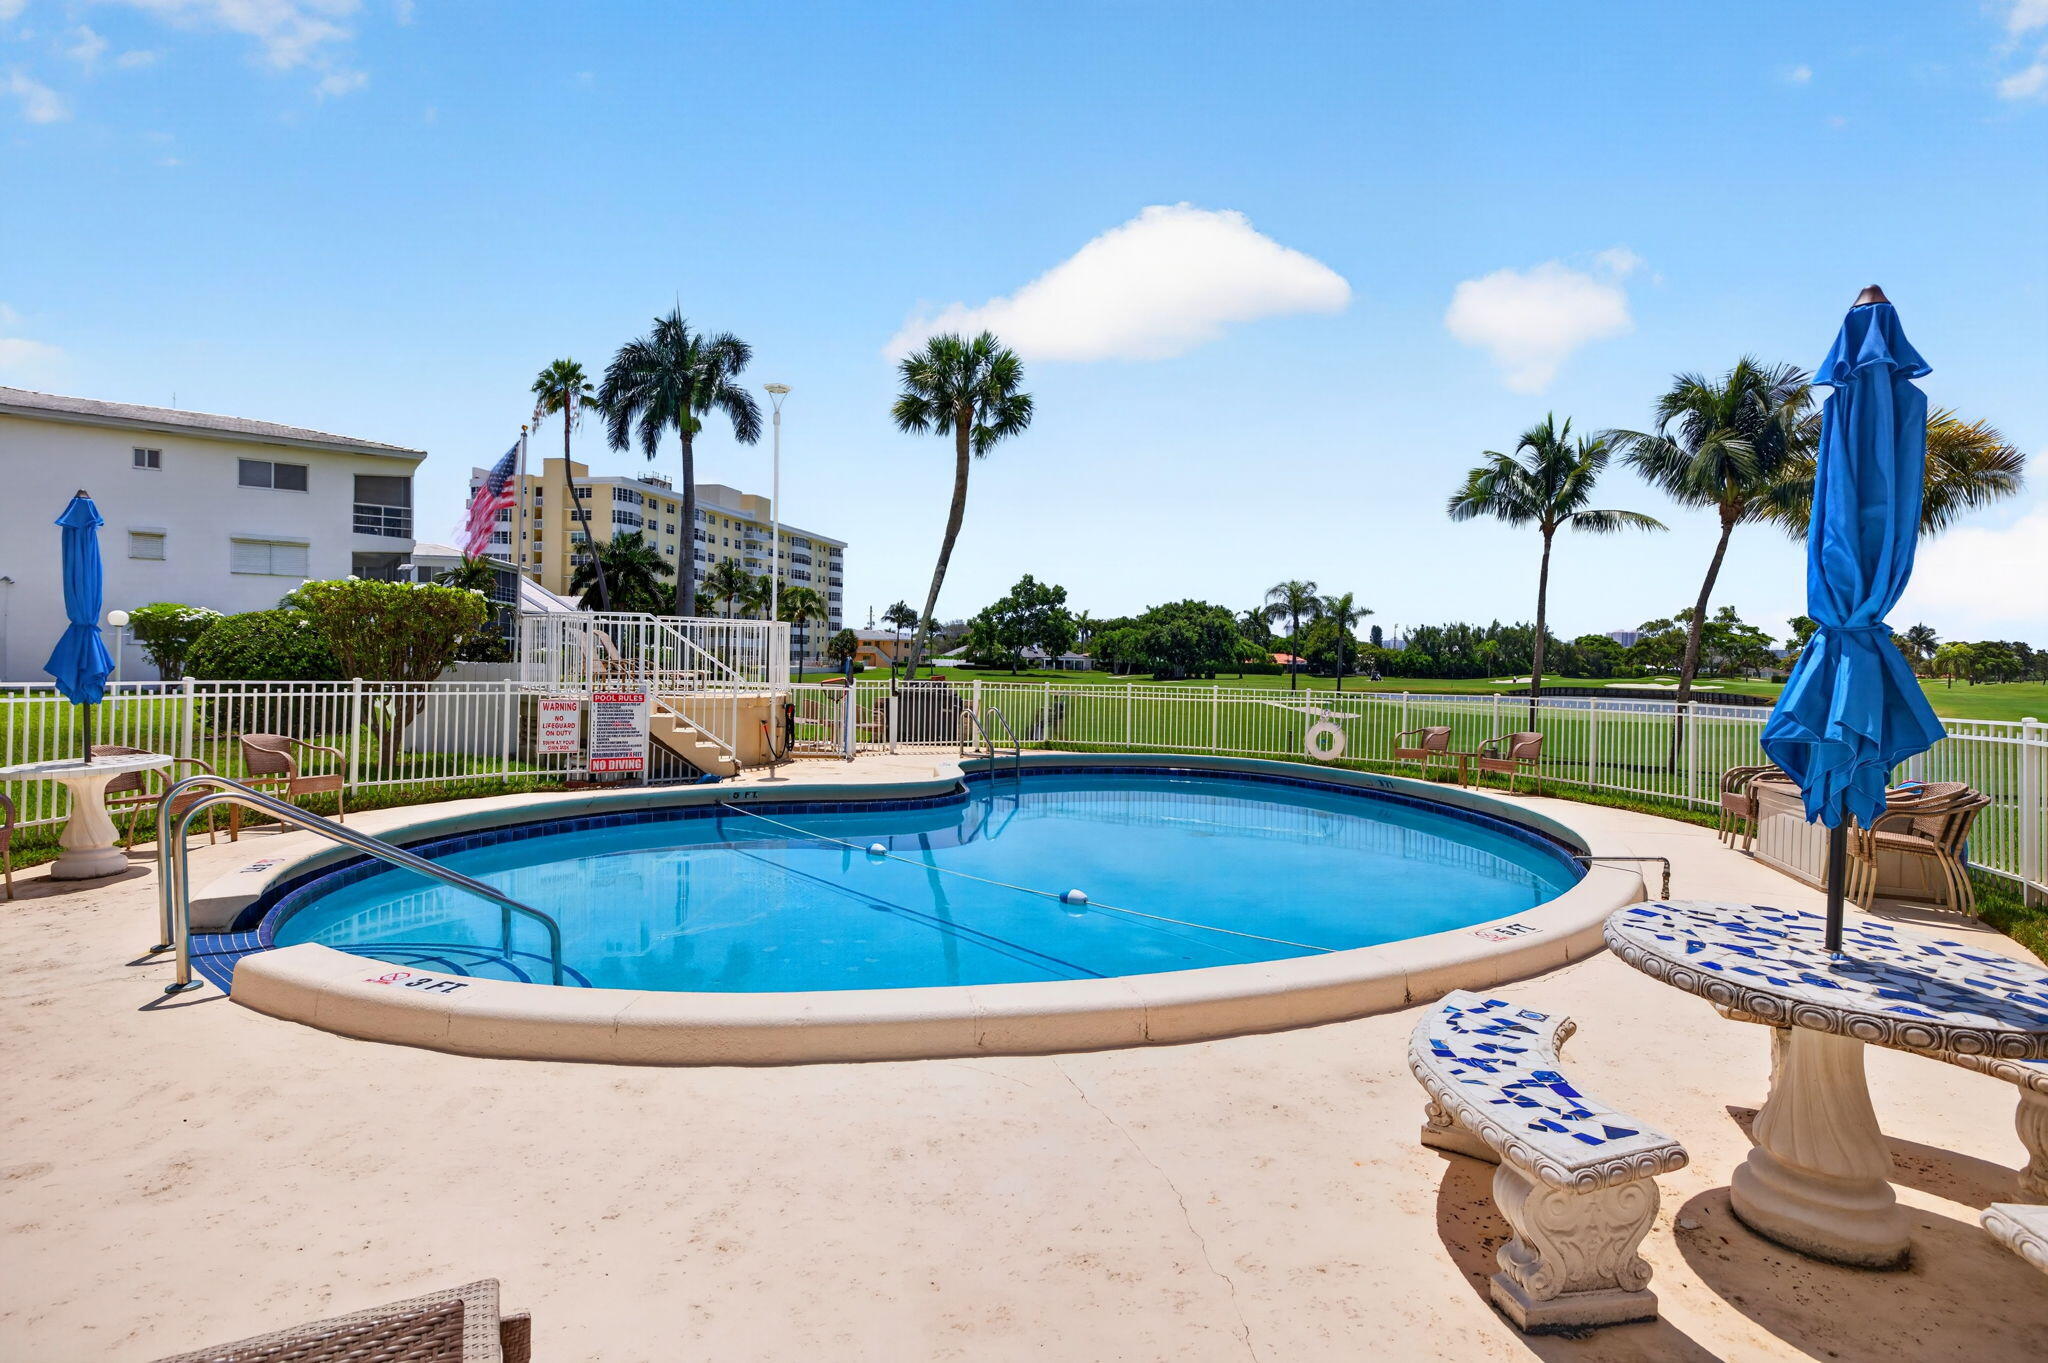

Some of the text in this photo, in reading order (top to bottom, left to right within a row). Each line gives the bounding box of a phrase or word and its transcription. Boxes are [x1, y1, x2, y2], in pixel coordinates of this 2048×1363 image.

[594, 694, 643, 702] POOL RULES
[542, 702, 577, 711] WARNING
[592, 759, 642, 770] NO DIVING
[1494, 928, 1517, 936] 5
[405, 978, 432, 987] 3
